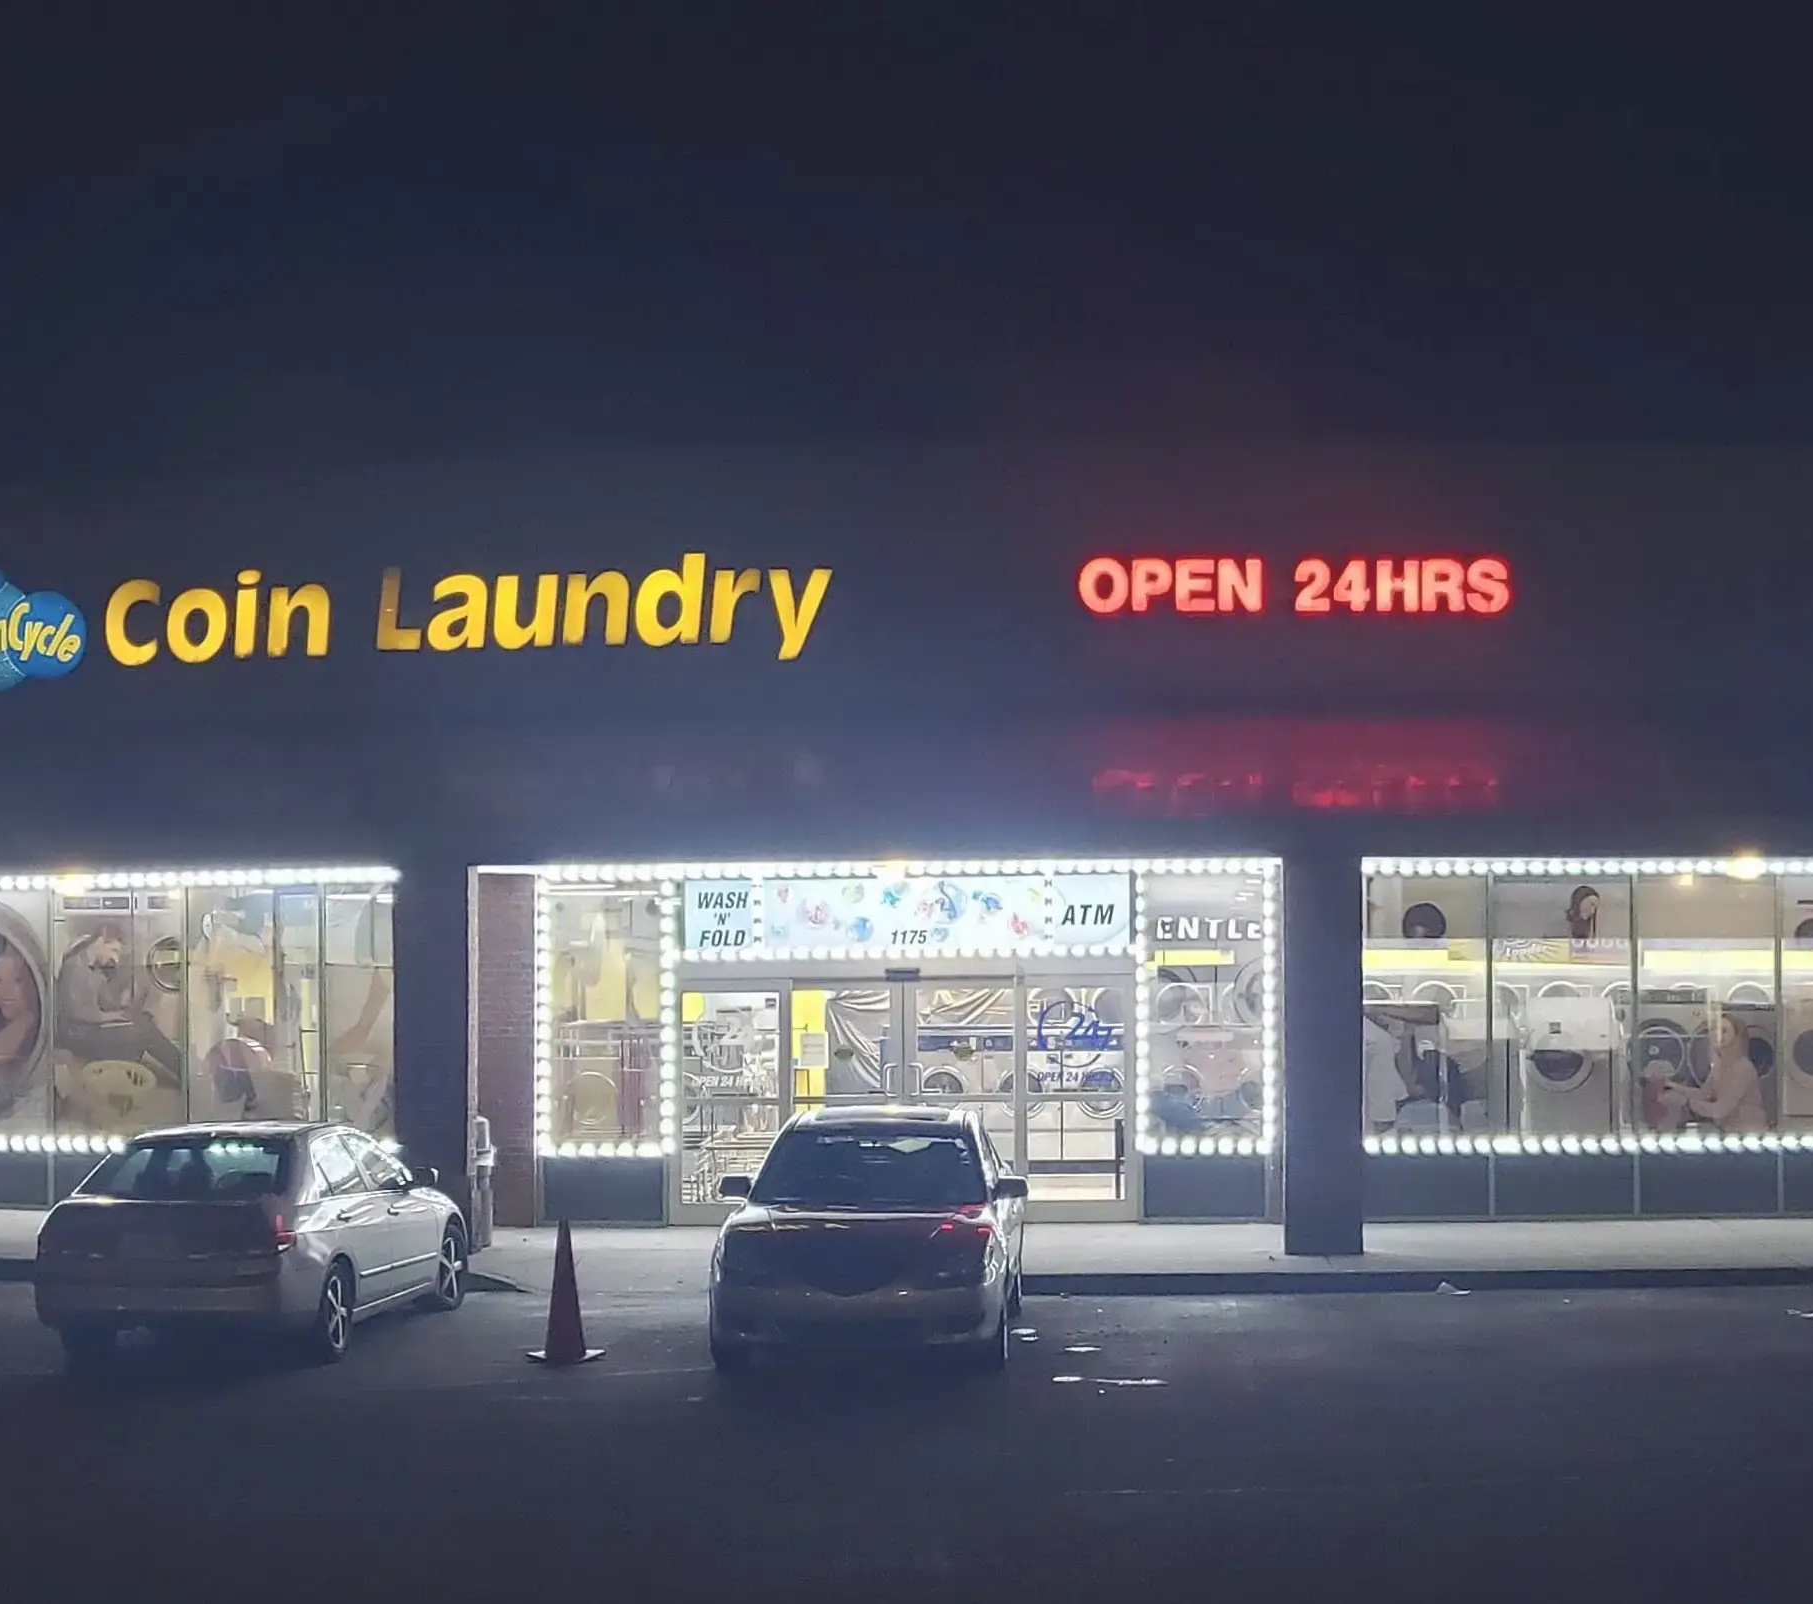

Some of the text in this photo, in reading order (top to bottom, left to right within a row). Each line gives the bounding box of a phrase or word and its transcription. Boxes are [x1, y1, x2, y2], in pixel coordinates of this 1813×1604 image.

[1078, 557, 1264, 614] OPEN
[104, 553, 833, 667] Coin Laundry
[697, 891, 749, 910] WASH
[1061, 904, 1115, 926] ATM
[699, 929, 746, 947] FOLD
[891, 929, 928, 945] 1175
